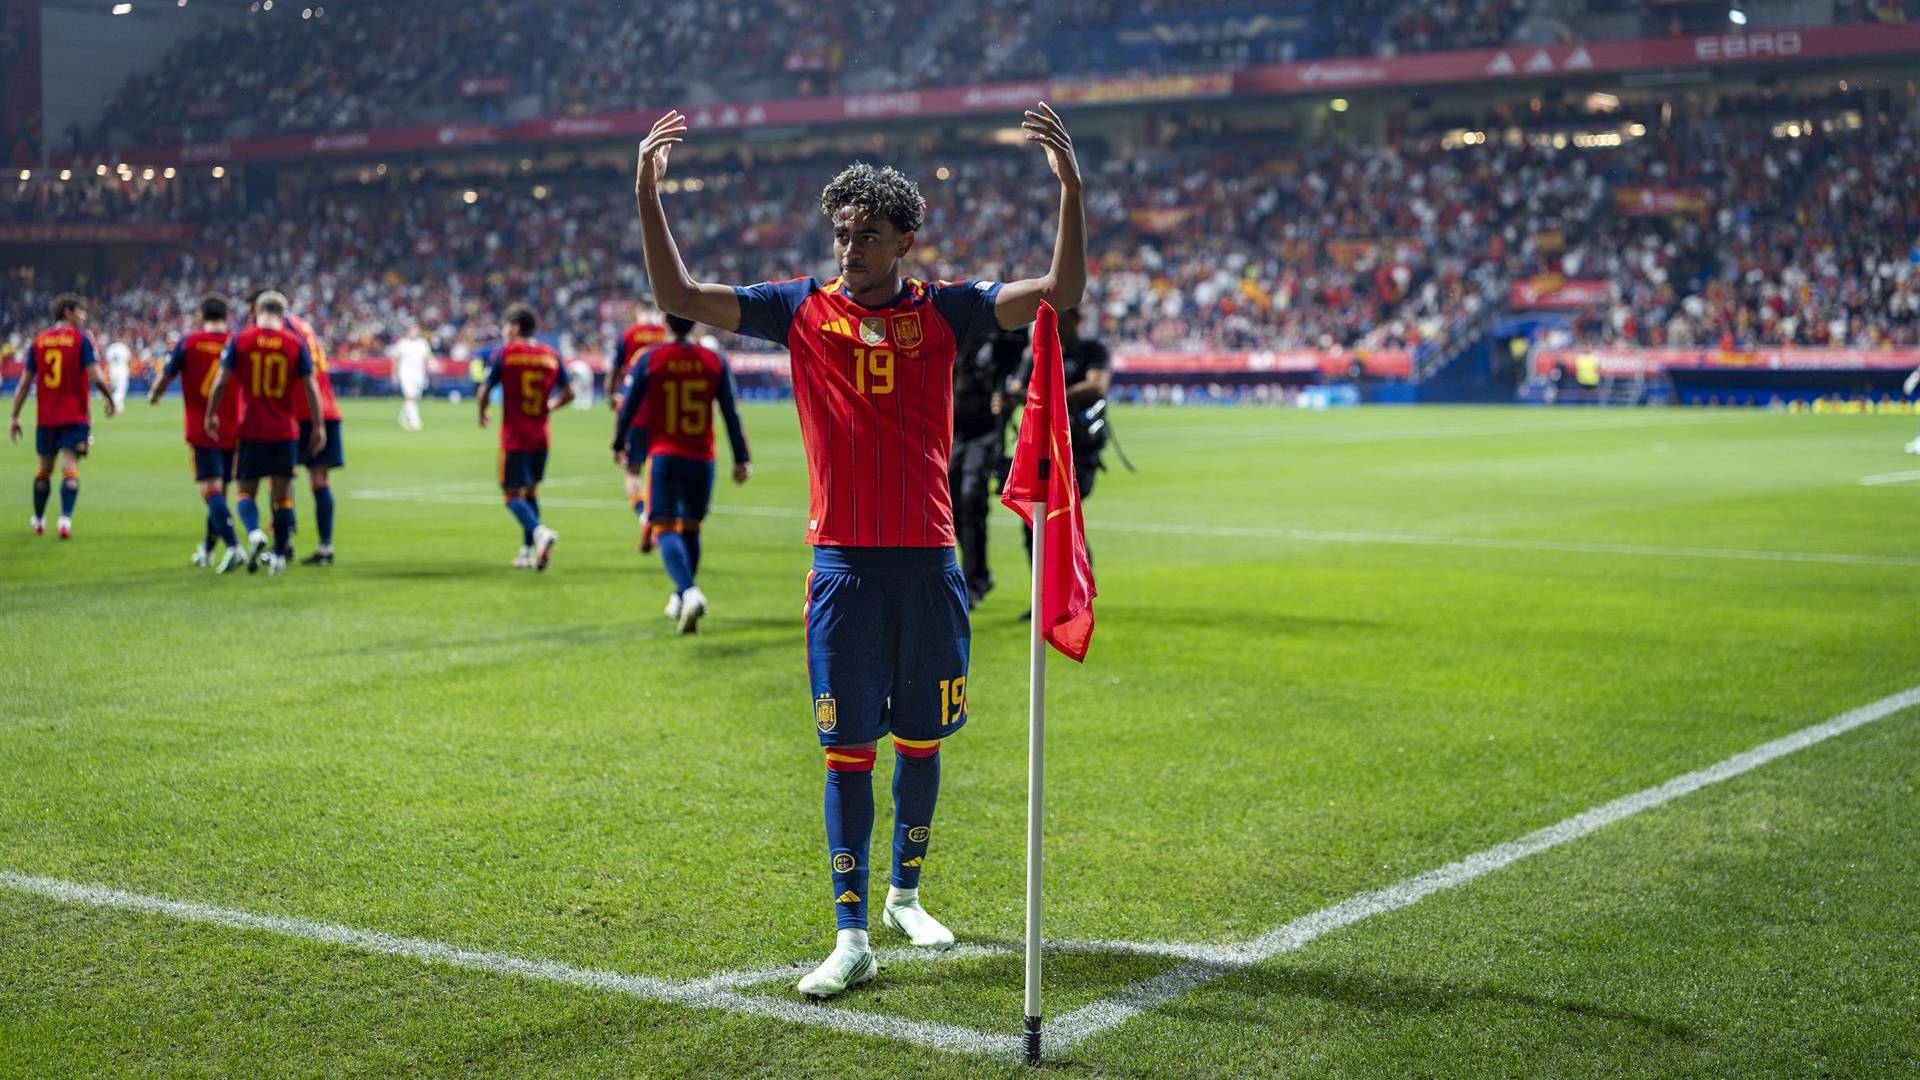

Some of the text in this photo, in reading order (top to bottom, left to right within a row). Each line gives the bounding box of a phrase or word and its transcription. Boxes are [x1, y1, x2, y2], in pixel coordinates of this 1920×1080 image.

[1695, 31, 1801, 61] EBRO
[44, 348, 62, 389] 3
[250, 351, 288, 398] 10
[854, 348, 894, 394] 19
[521, 371, 545, 416] 5
[663, 380, 708, 435] 15
[940, 676, 967, 726] 19
